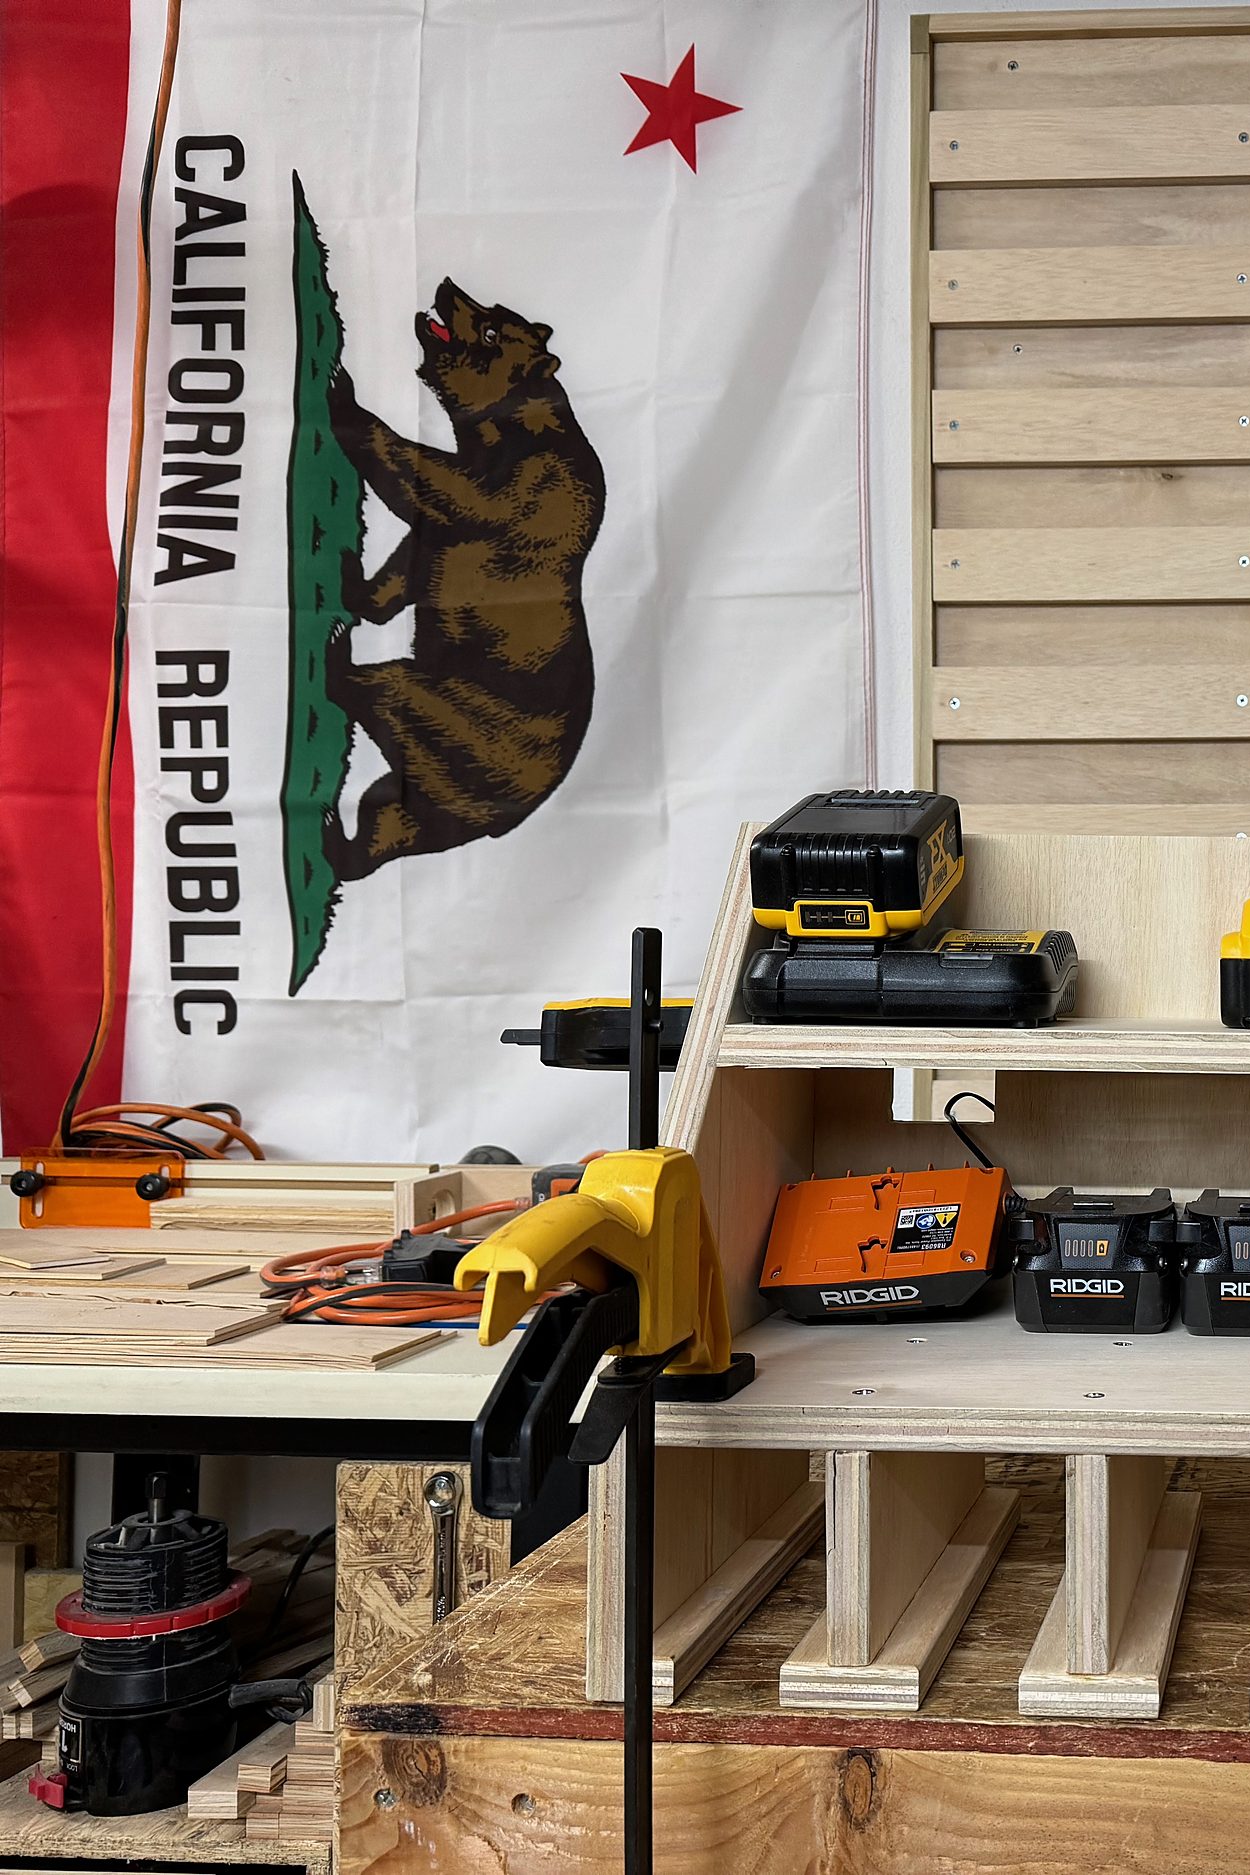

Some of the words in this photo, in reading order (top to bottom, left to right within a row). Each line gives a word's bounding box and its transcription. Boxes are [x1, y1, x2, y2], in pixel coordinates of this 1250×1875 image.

[153, 134, 247, 587] CALIFORNIA
[155, 650, 241, 1035] REPUBLIC
[819, 1285, 920, 1306] RIDGID
[1049, 1278, 1125, 1294] RIDGID
